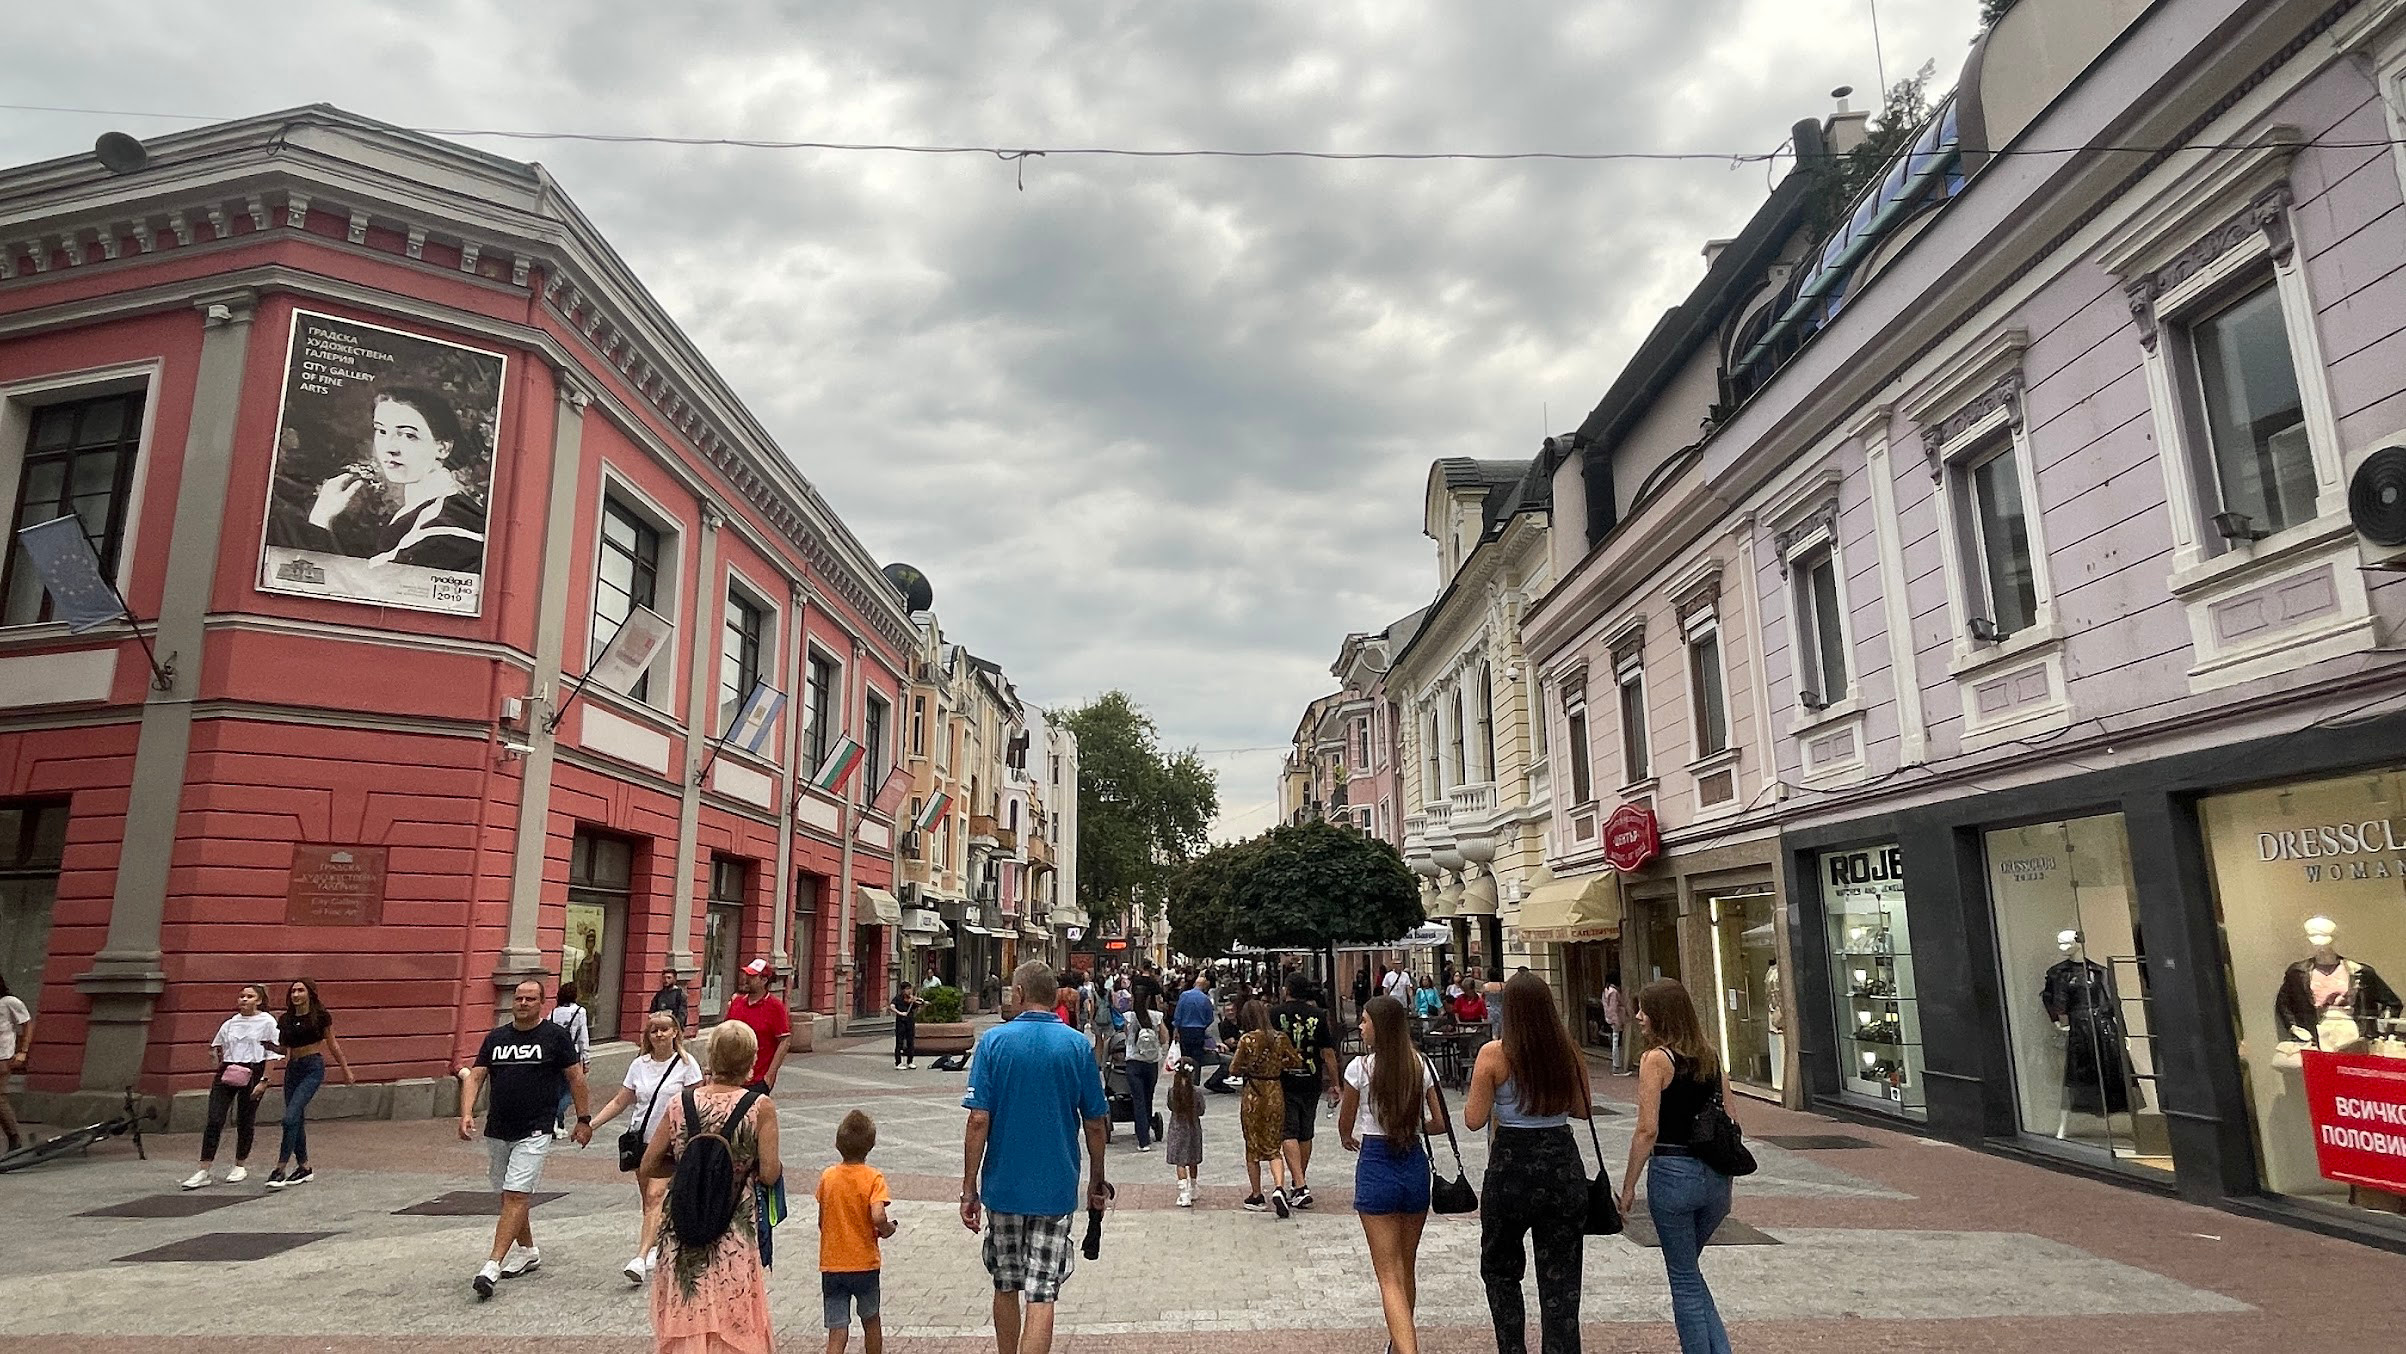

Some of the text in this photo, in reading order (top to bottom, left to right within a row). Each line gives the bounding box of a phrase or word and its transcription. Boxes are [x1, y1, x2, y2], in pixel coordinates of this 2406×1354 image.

[308, 326, 358, 345] ГРАДСКА
[305, 347, 355, 365] ГАЛЕРИЯ
[306, 337, 394, 363] ХУДОЖЕСТВЕНА
[301, 371, 343, 387] OF FINE
[303, 361, 375, 382] CITY GALLERY
[299, 382, 329, 395] ARTS
[492, 1044, 543, 1061] NASA
[2335, 1096, 2406, 1126] ВСИЧКО
